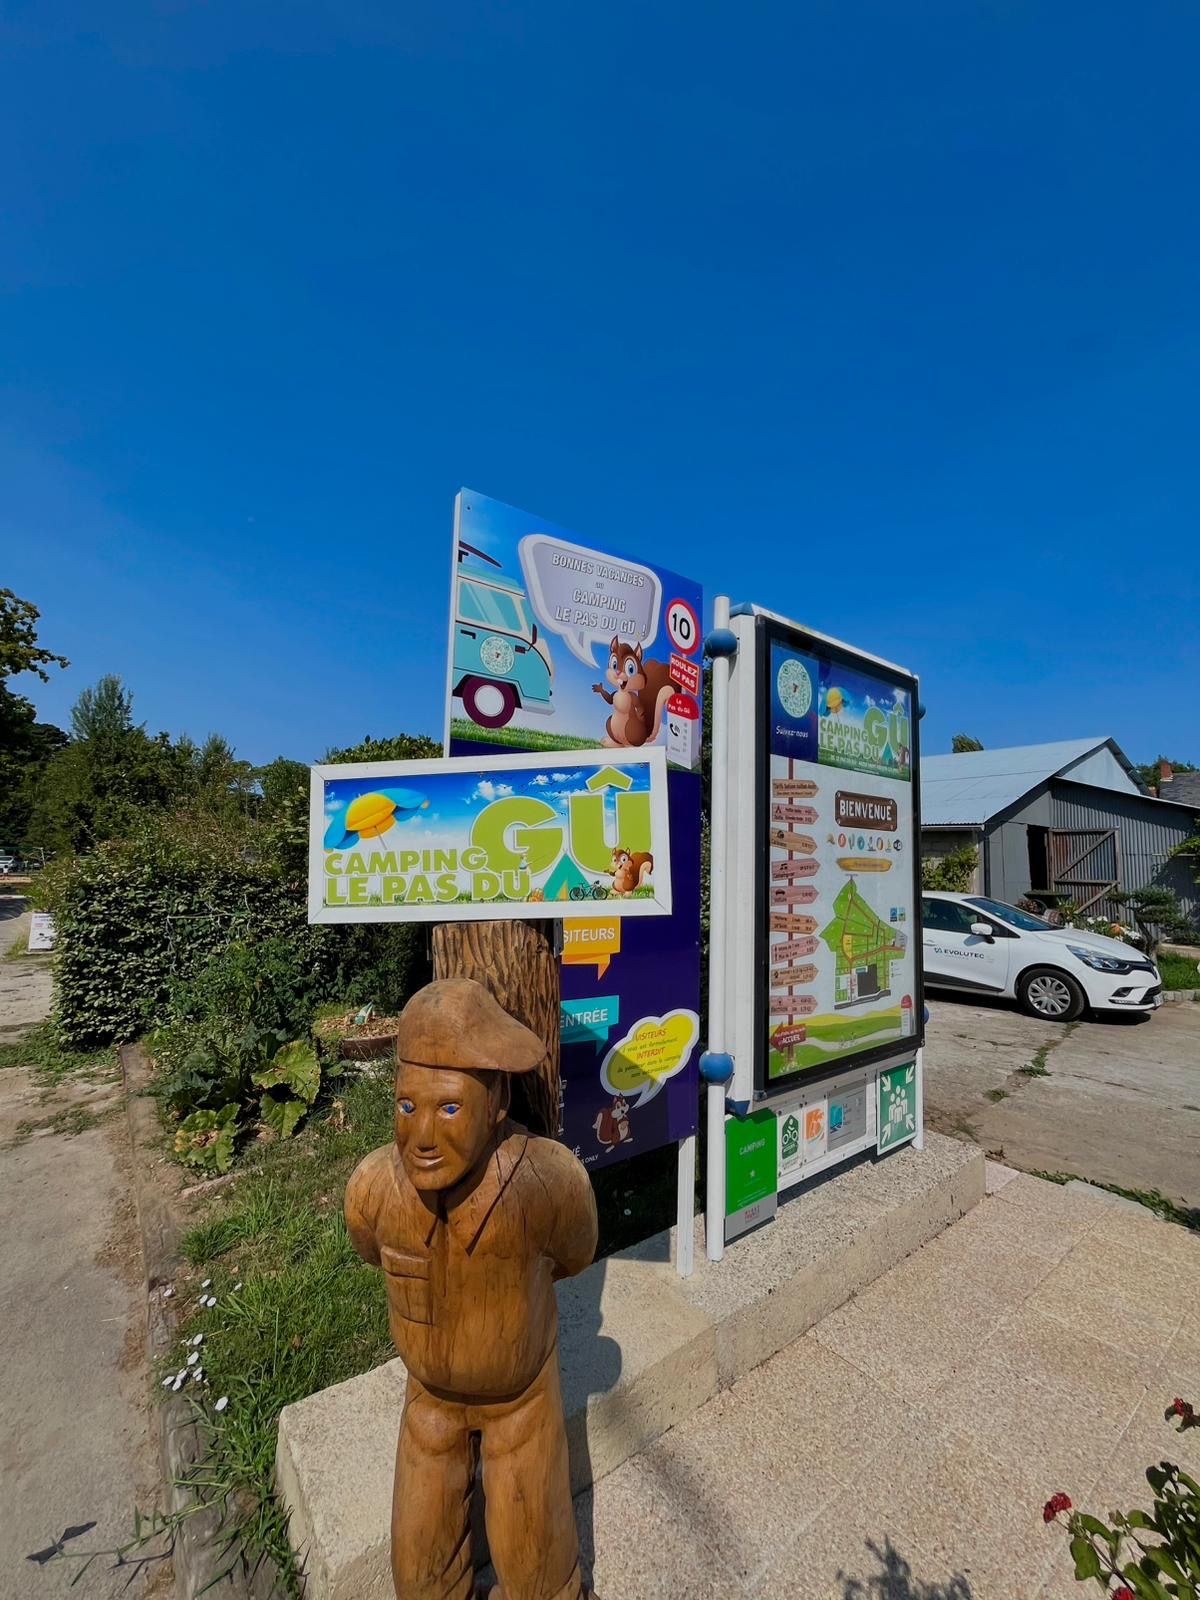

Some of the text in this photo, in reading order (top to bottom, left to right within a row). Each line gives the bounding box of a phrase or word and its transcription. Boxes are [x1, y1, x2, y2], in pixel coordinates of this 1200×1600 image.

[552, 553, 645, 587] BONNES VACANCES
[573, 589, 626, 613] CAMPING
[555, 606, 571, 622] LE
[574, 610, 598, 628] PAS
[600, 616, 617, 631] DU
[672, 612, 690, 640] 10
[671, 657, 698, 677] ROULEZ
[672, 668, 695, 688] AU PAS
[820, 718, 868, 742] CAMPING
[820, 732, 880, 761] LE PAS DU
[840, 800, 892, 821] BIENVENUE
[323, 846, 488, 877] CAMPING
[325, 869, 531, 906] LE PAS DU
[944, 948, 985, 959] EVOLUTEC
